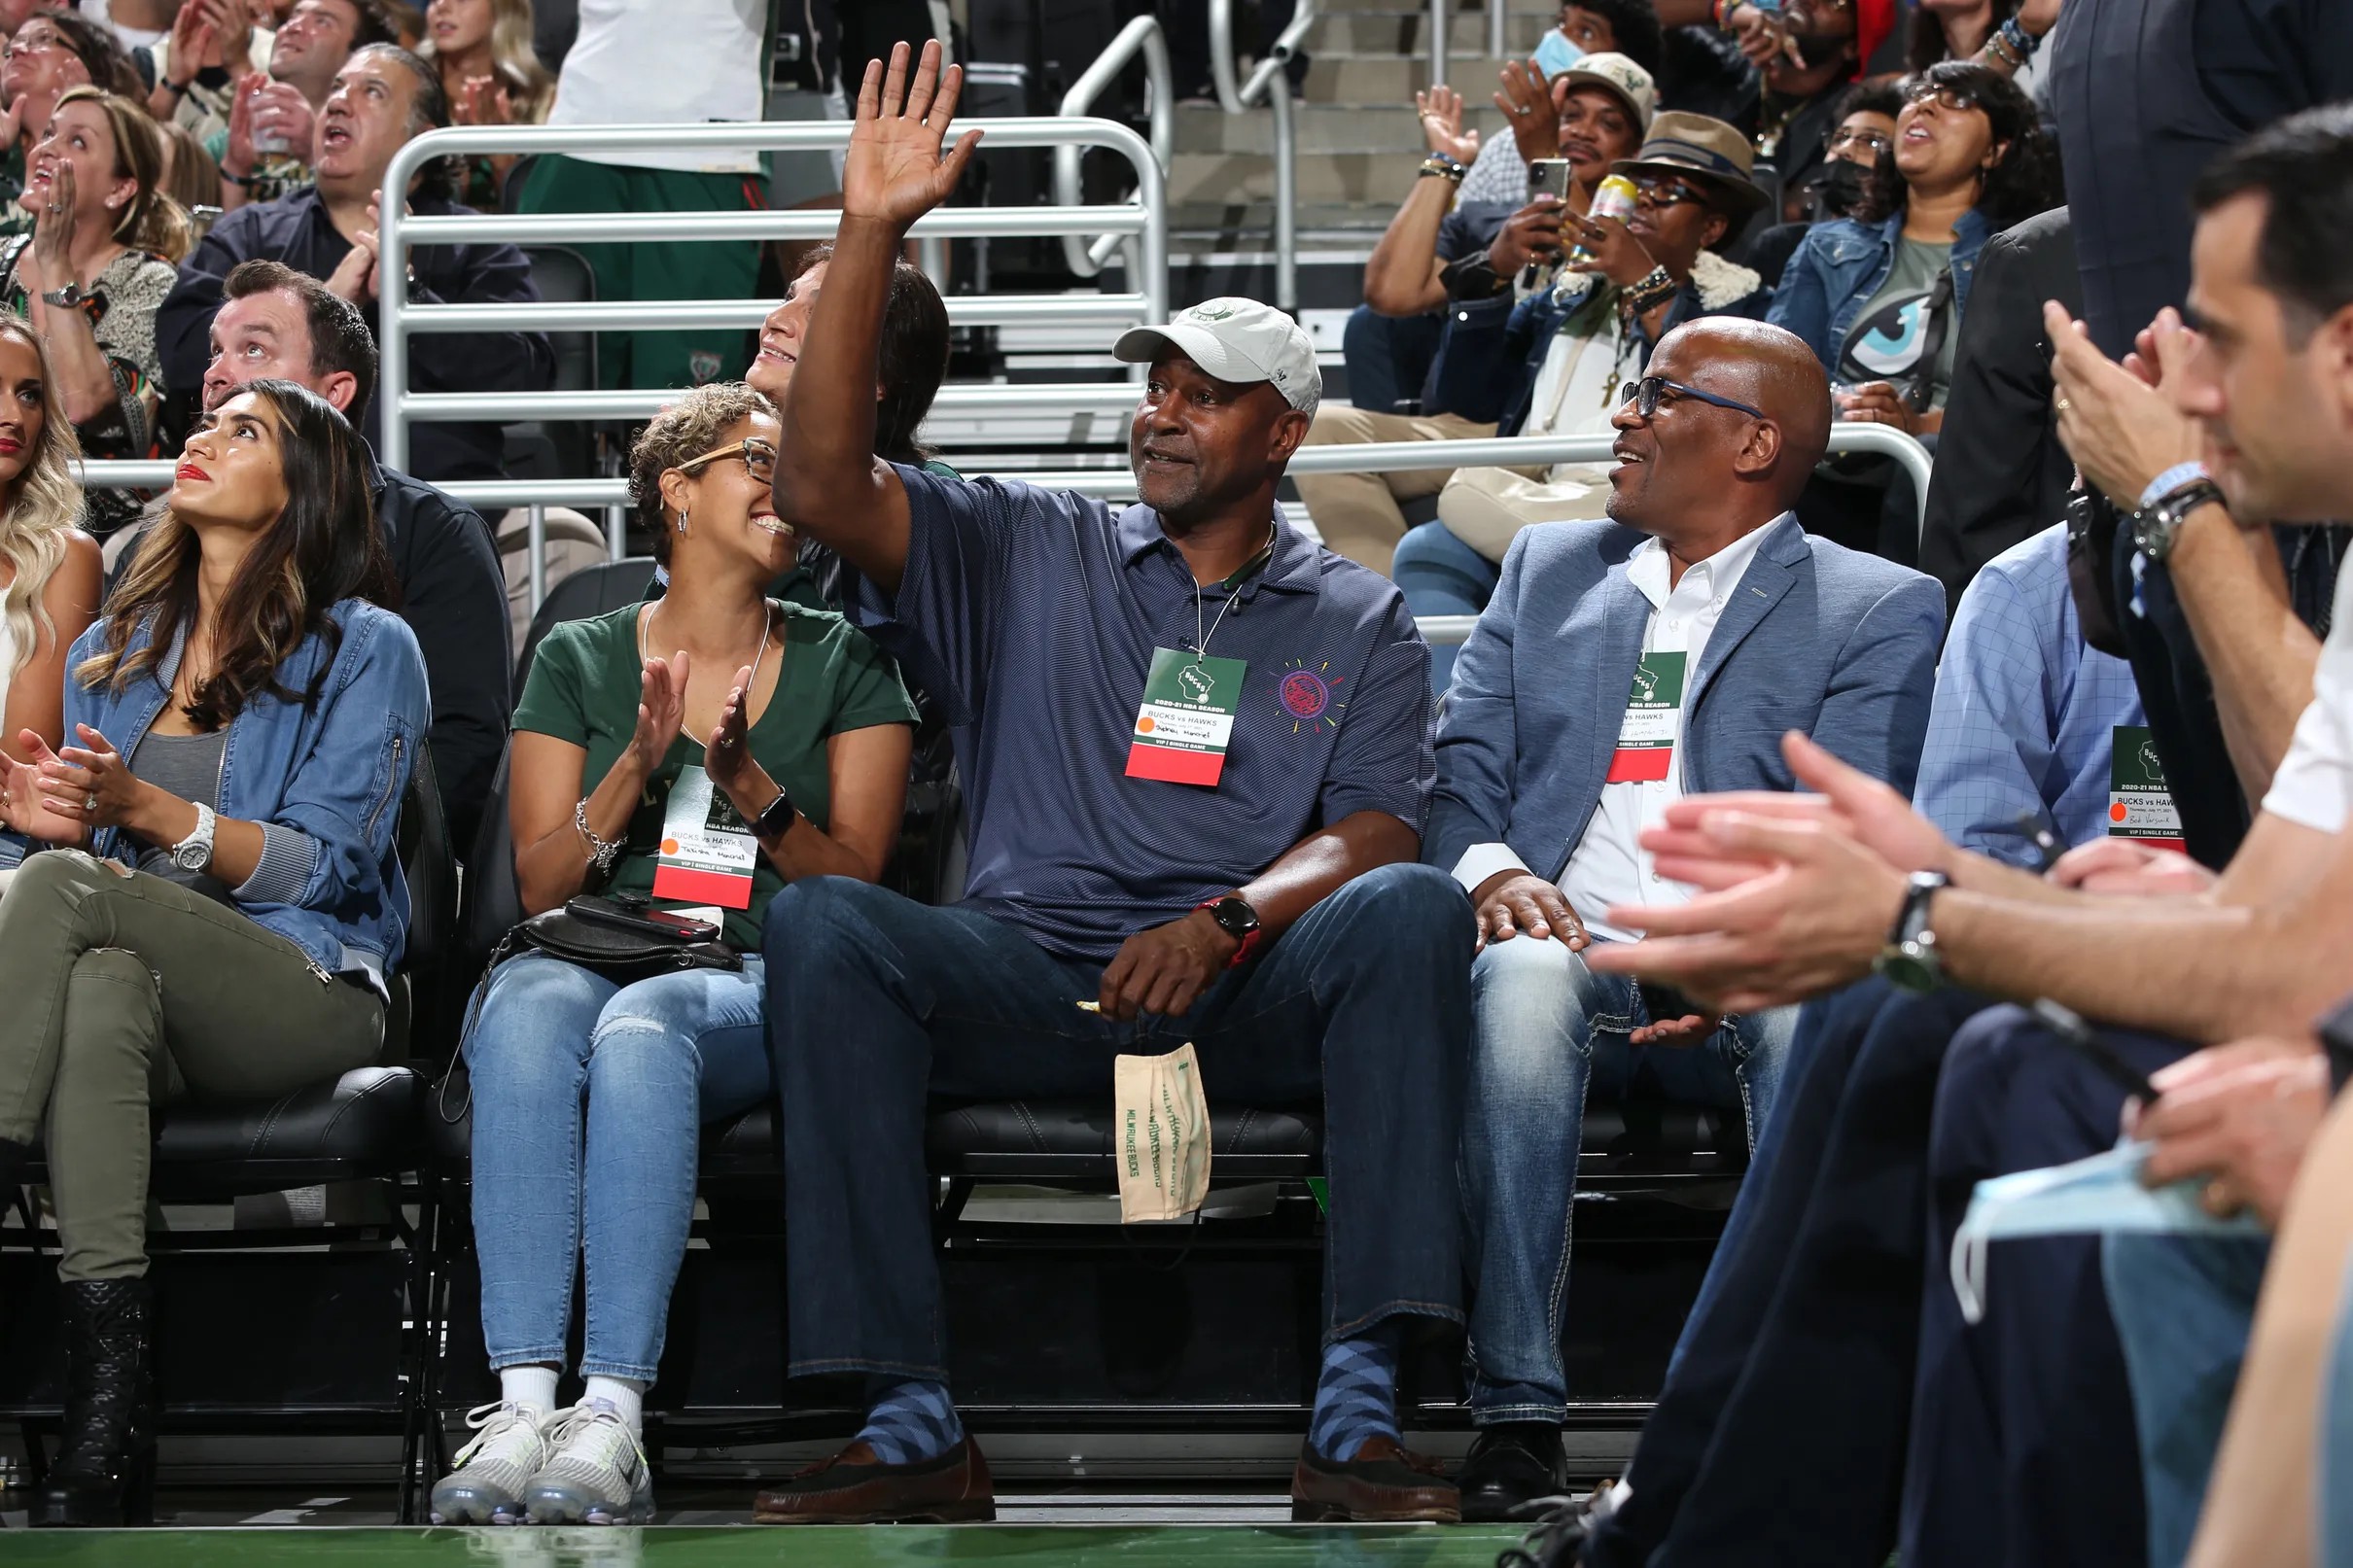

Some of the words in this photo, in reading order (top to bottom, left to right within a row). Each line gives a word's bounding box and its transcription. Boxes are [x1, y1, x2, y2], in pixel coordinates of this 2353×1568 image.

[1184, 671, 1206, 692] BUCKS
[1633, 674, 1650, 690] UCKS
[1198, 704, 1225, 714] SEASON
[1147, 710, 1176, 720] BUCKS
[1188, 714, 1217, 727] HAWKS
[2144, 749, 2160, 767] BUC
[2118, 797, 2144, 806] BUCKS
[721, 824, 750, 834] SEASON
[671, 831, 699, 841] BUCKS
[712, 836, 743, 848] HAWKS
[1126, 1109, 1137, 1154] MILWAUKEE
[1127, 1154, 1140, 1177] BUCKS
